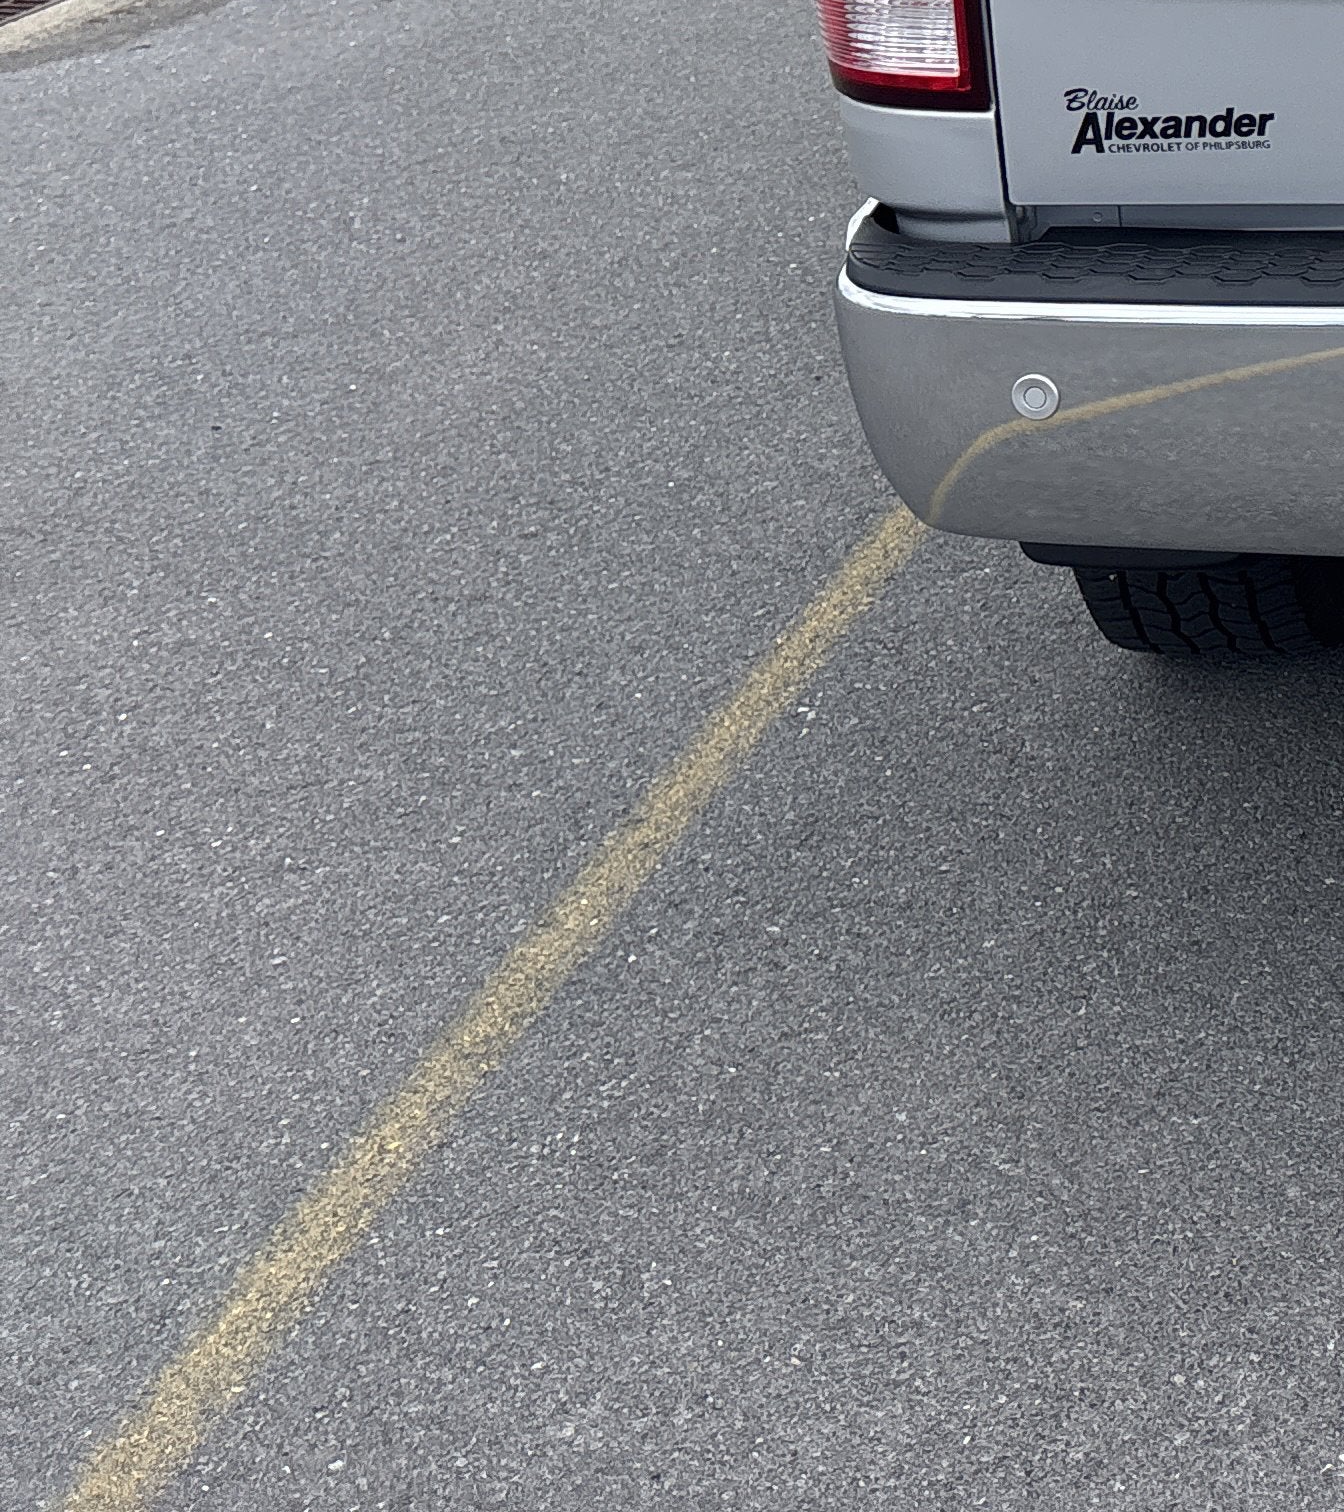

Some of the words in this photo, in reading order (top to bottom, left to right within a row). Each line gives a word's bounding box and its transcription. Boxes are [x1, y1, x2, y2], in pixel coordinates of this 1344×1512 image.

[1063, 88, 1140, 112] Blaise
[1070, 107, 1276, 155] Alexander
[1108, 142, 1183, 154] CHEVROLET
[1185, 141, 1201, 152] OF
[1202, 139, 1272, 151] PHILIPSBURG
